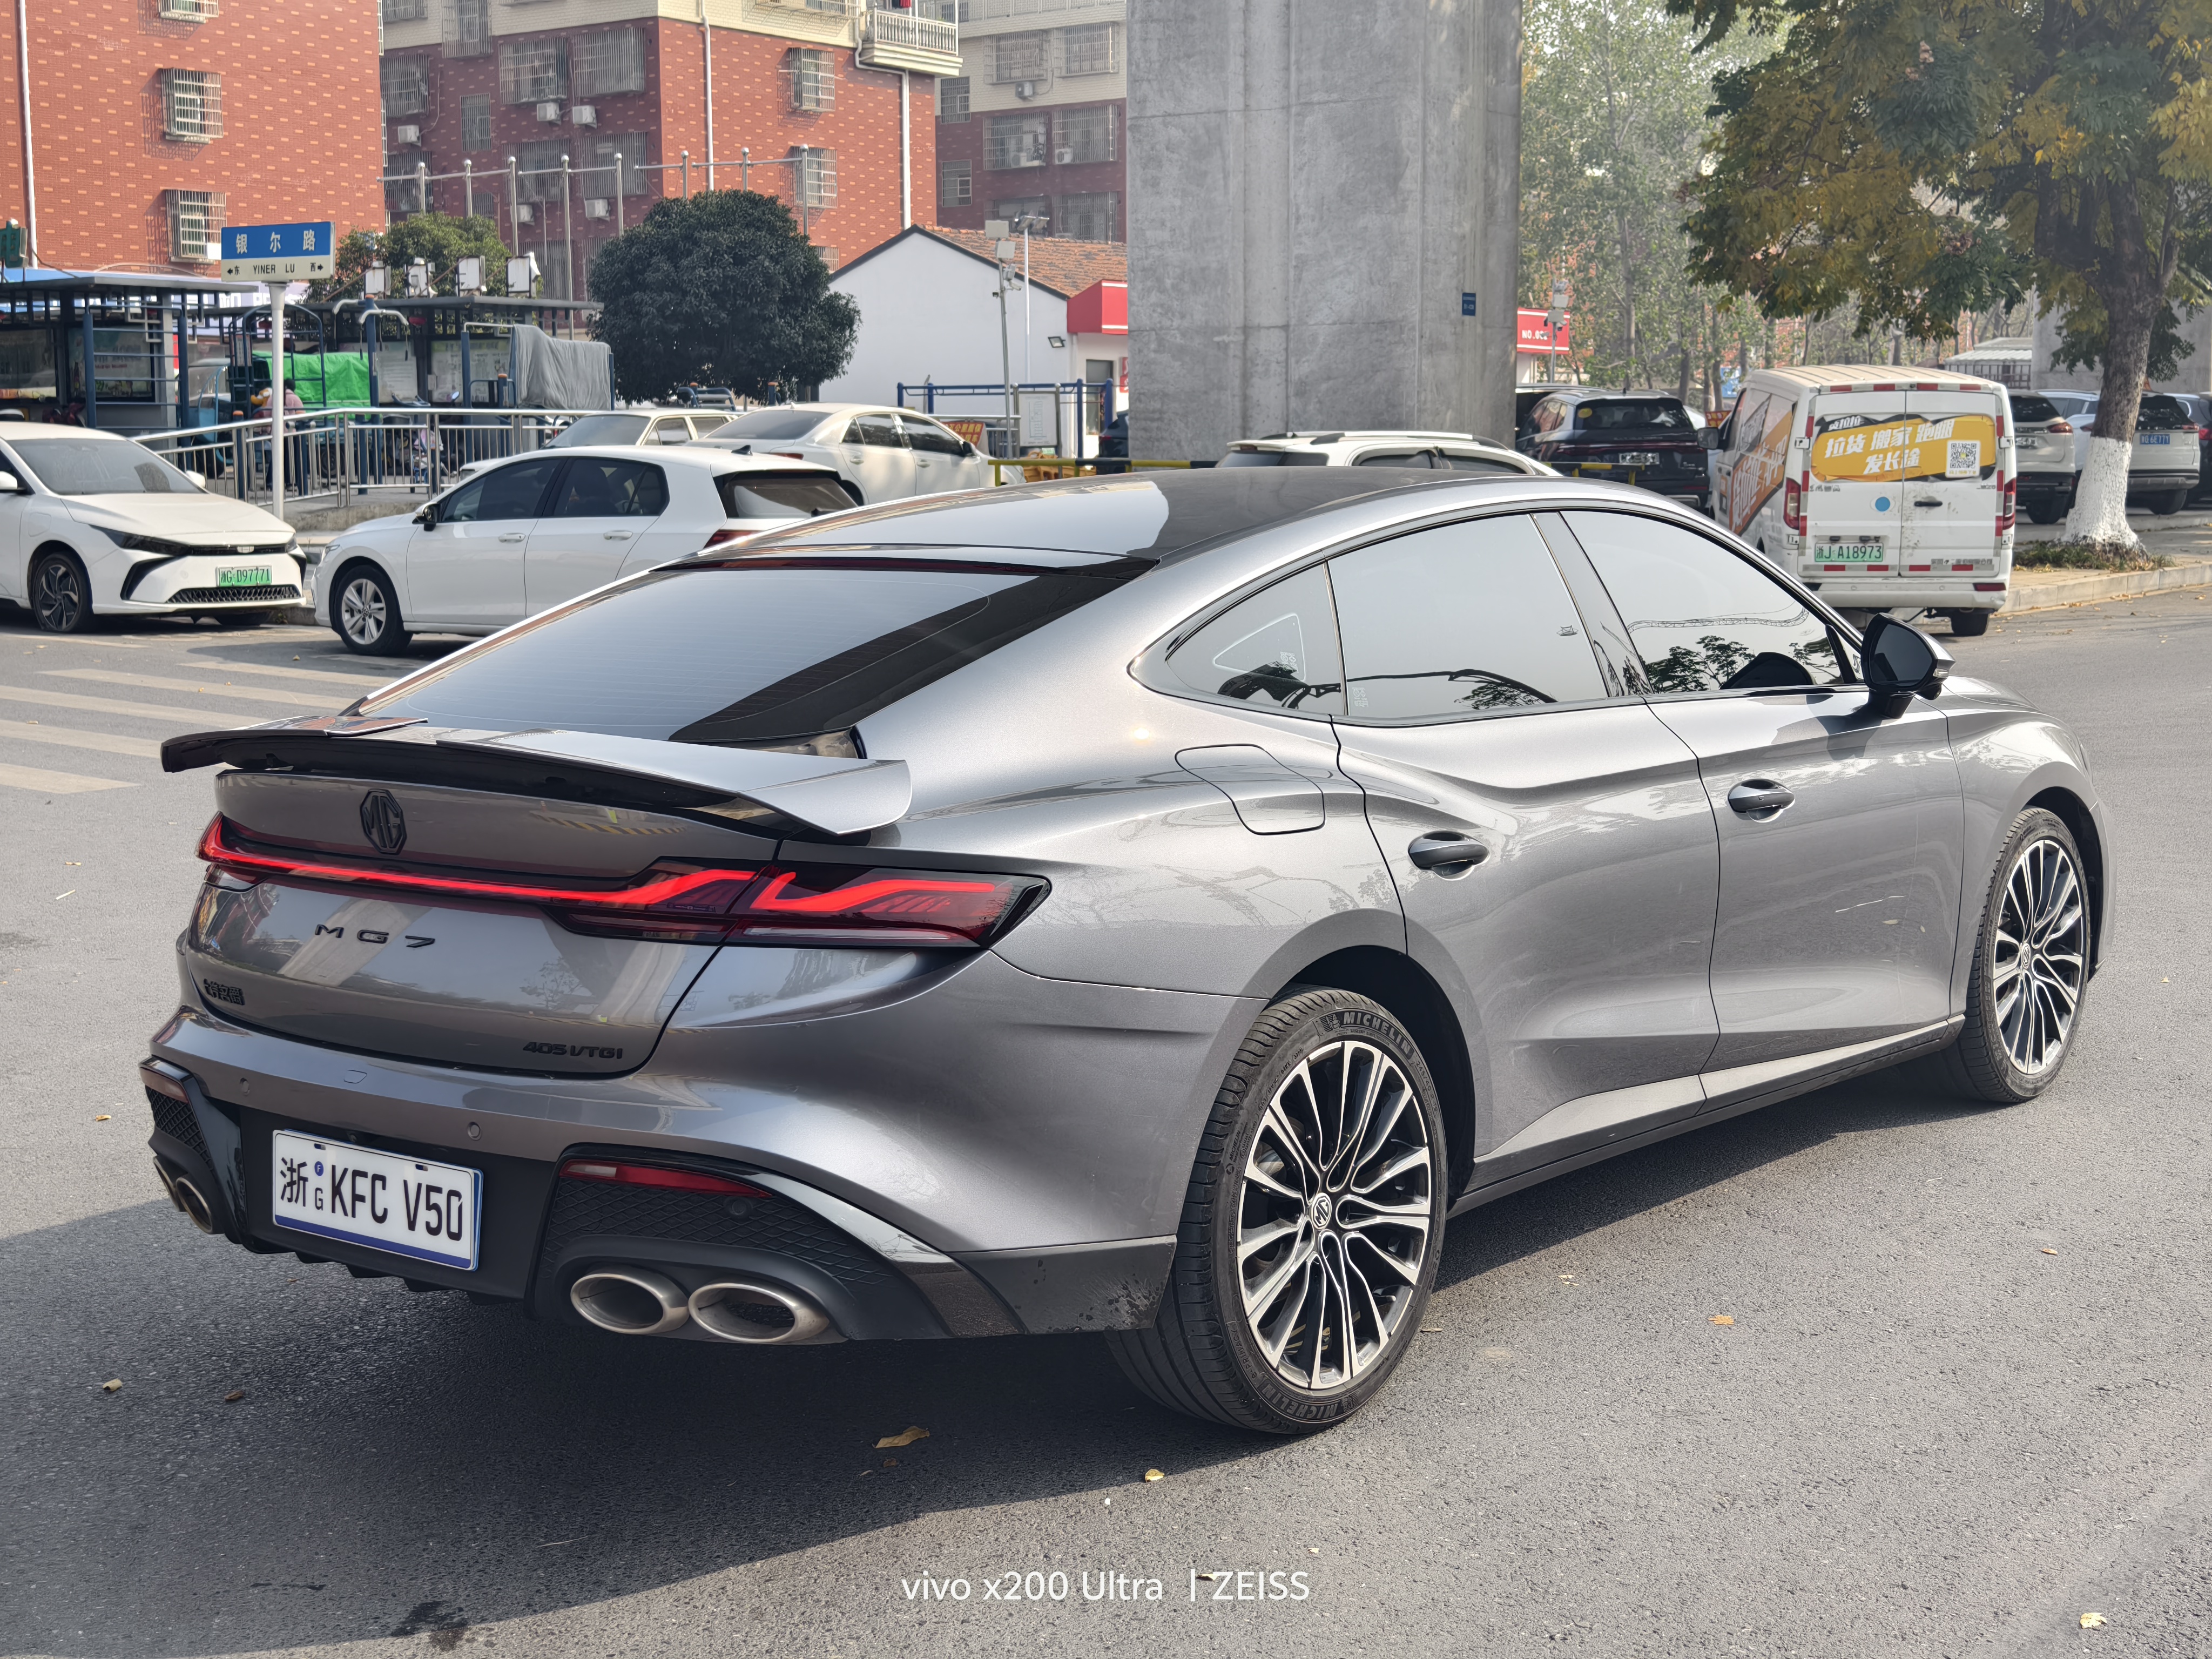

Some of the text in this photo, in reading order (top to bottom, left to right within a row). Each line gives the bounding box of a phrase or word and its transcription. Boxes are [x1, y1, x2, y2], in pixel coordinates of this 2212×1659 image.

[236, 230, 315, 254] 银尔路
[234, 262, 316, 275] 东 YINER LU 西
[1824, 419, 1955, 458] 拉货 搬家 跑腿
[1863, 448, 1920, 475] 发长途
[362, 794, 401, 849] MG
[1344, 1011, 1412, 1055] MICHELIN
[1229, 1130, 1240, 1161] MICHELIN
[280, 1157, 463, 1241] 浙 G KFC V50
[1262, 1384, 1338, 1419] MICHELIN
